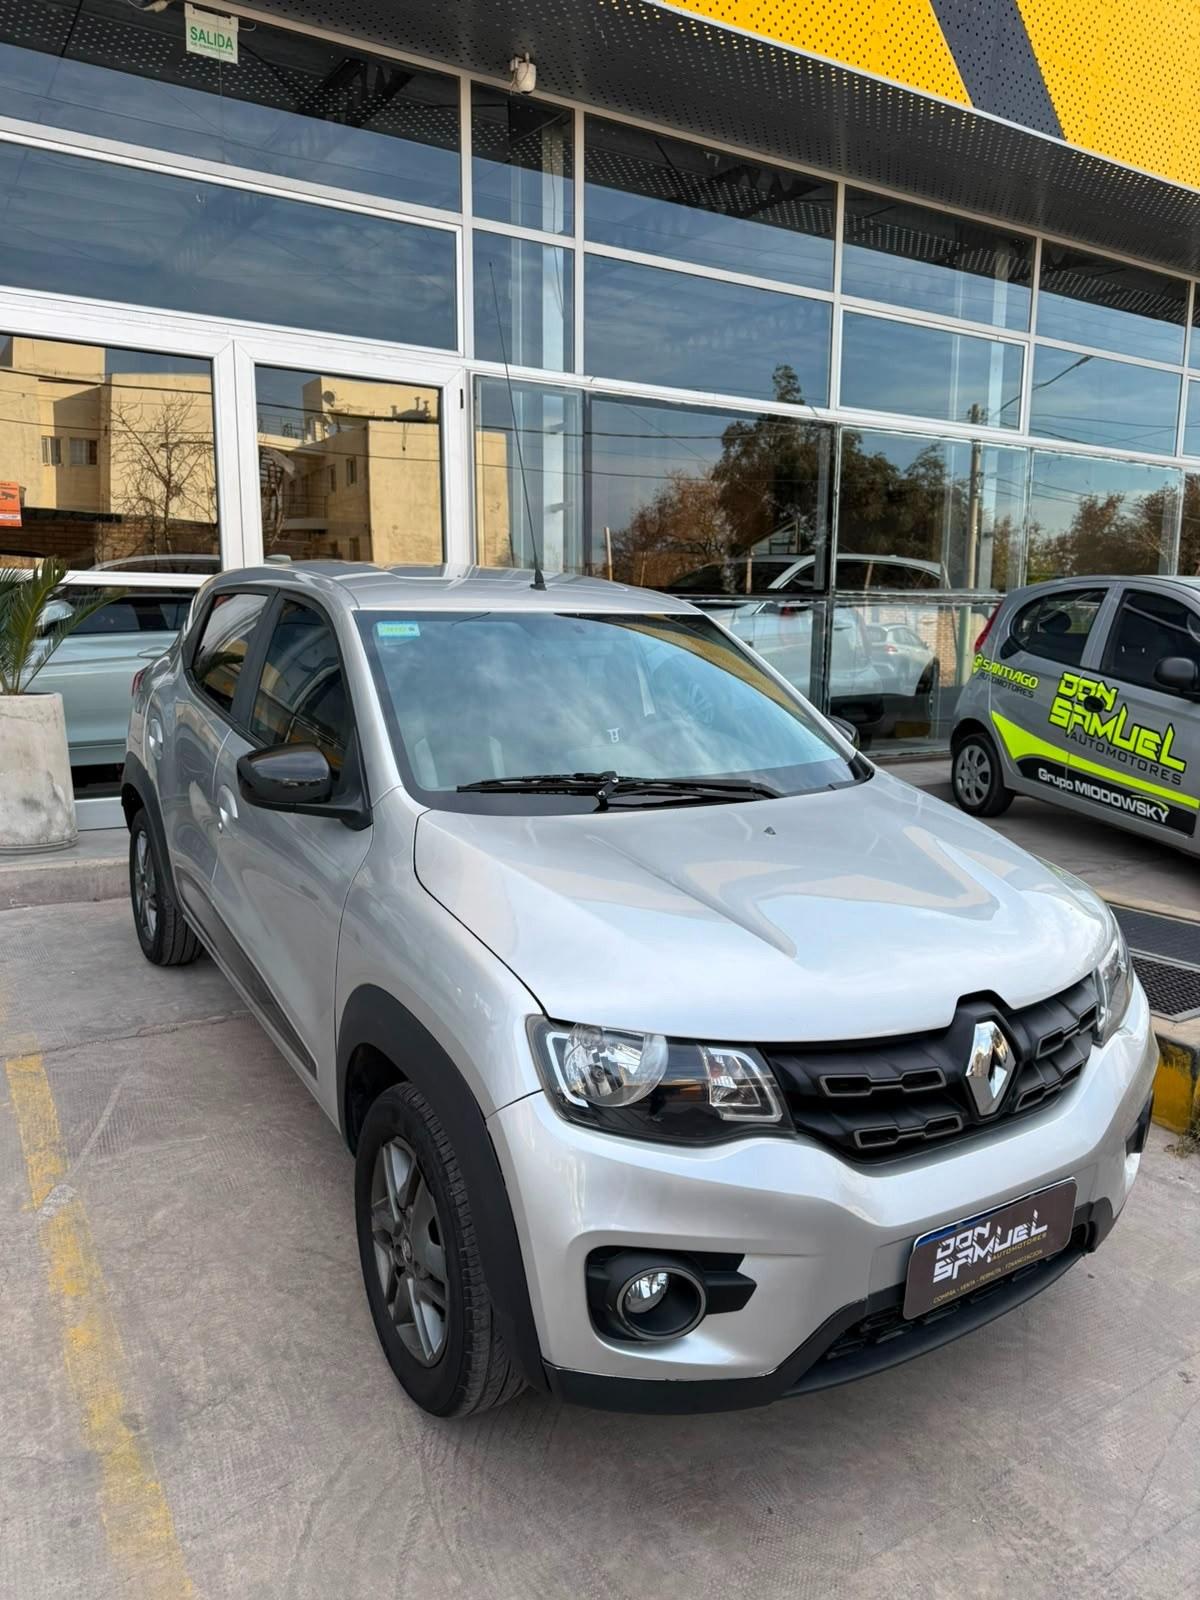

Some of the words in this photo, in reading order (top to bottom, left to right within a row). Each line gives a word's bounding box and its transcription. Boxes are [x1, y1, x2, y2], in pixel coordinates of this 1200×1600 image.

[190, 26, 234, 51] SALIDA
[982, 659, 1039, 690] SANTIAGO
[1057, 672, 1118, 712] DON
[1048, 703, 1187, 774] SAMUEL
[1070, 732, 1183, 786] AUTOMOTORES
[1038, 767, 1075, 791] Grupo
[1074, 780, 1170, 823] MIODOWSKY
[932, 1209, 1048, 1283] SAMUEL
[936, 1221, 991, 1260] DON
[991, 1232, 1047, 1261] AUTOMOTORES
